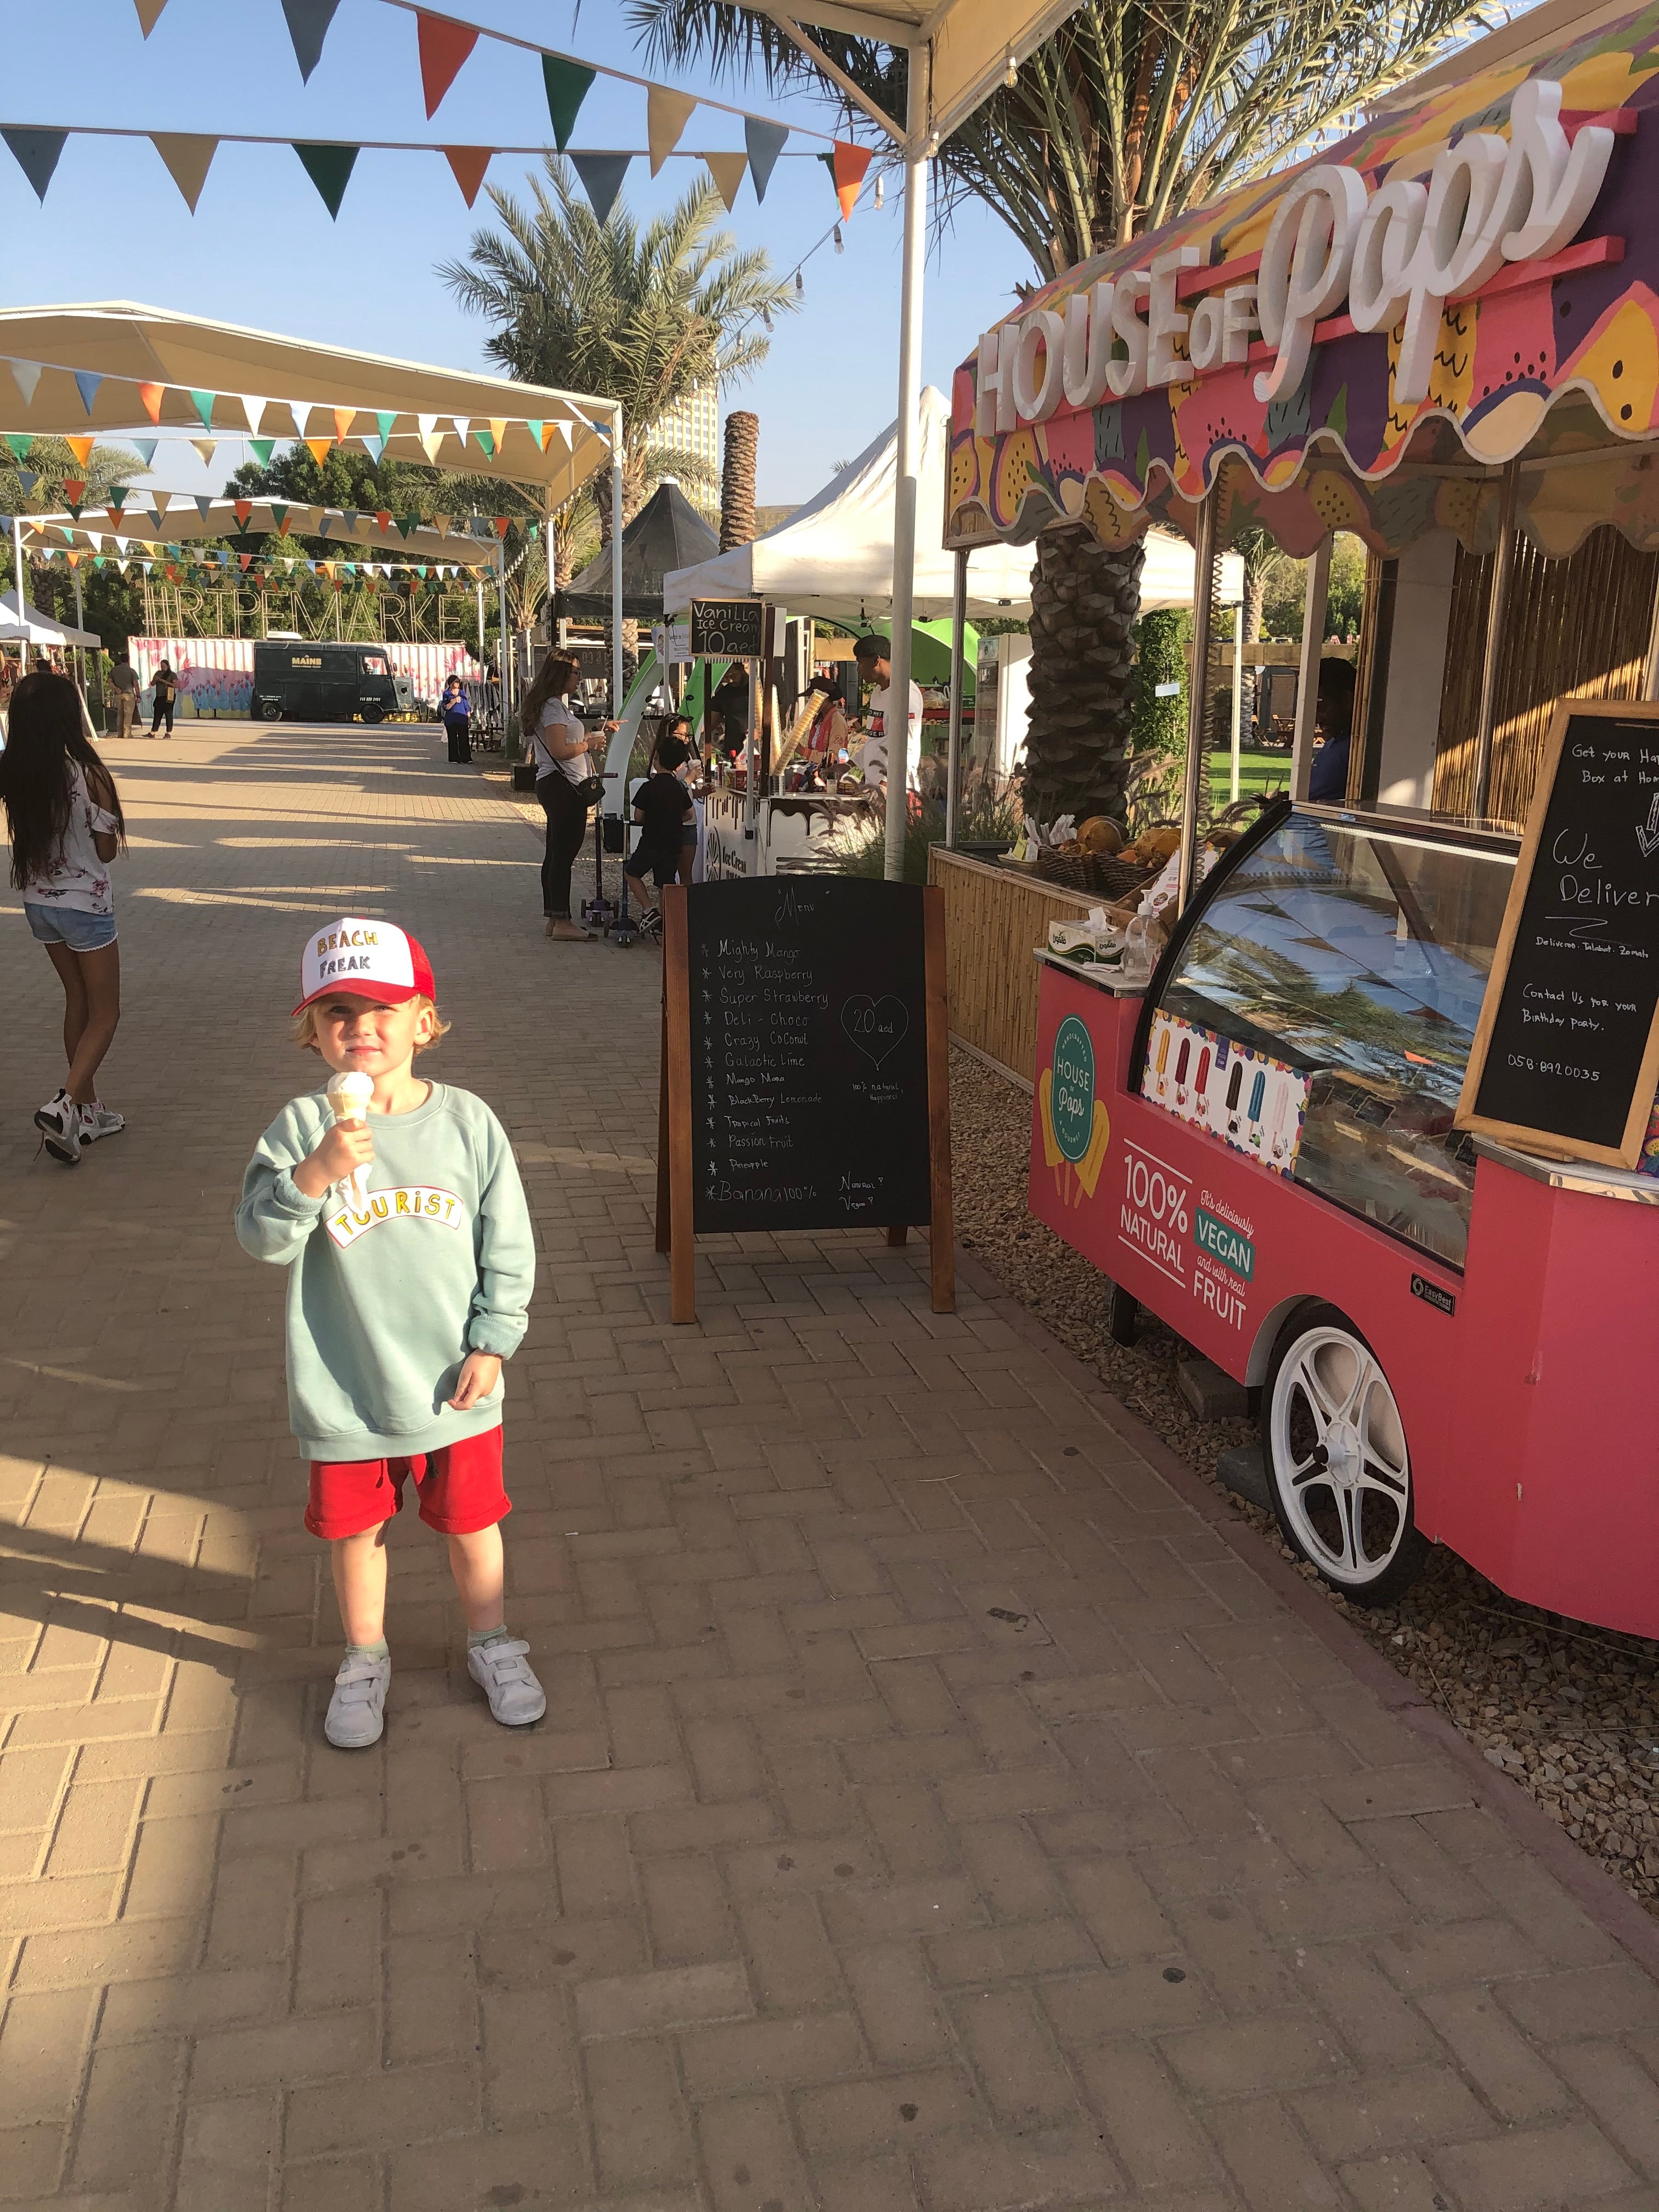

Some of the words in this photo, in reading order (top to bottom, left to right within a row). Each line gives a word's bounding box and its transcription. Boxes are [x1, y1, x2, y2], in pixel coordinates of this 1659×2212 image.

[975, 247, 1200, 438] HOUSE
[1188, 284, 1260, 369] OF
[1254, 80, 1615, 404] Pops
[693, 602, 759, 622] Vanilla
[696, 619, 715, 630] Ice
[720, 619, 760, 633] Cream
[698, 630, 725, 654] 10
[727, 635, 758, 653] aed
[1572, 743, 1595, 758] Get
[1582, 770, 1605, 784] Box
[1613, 770, 1628, 783] at
[723, 846, 731, 866] Ice
[1553, 828, 1602, 869] We
[1560, 874, 1659, 906] Deliver
[317, 930, 379, 957] BEACH
[717, 939, 758, 963] Mighty
[766, 941, 801, 965] Mango
[1618, 945, 1649, 959] Zomato
[320, 956, 371, 979] FREAK
[719, 965, 745, 985] Very
[754, 965, 813, 987] Raspberry
[720, 987, 758, 1007] Super
[764, 988, 828, 1009] Strawberry
[1522, 983, 1565, 1001] Contact
[1571, 991, 1584, 1005] Us
[725, 1011, 751, 1025] Deli
[771, 1012, 809, 1026] Choco
[854, 1009, 875, 1033] 20
[878, 1022, 894, 1033] aed
[1521, 1007, 1565, 1026] Birthday
[725, 1032, 760, 1052] Crazy
[1062, 1032, 1087, 1062] HANDCRAFTED
[725, 1052, 776, 1067] Galactic
[781, 1052, 805, 1066] Lime
[1508, 1053, 1601, 1081] 058-8920035
[726, 1072, 755, 1086] Mango
[1057, 1056, 1090, 1092] HOUSE
[852, 1081, 867, 1092] 100%
[781, 1092, 822, 1104] Lemonade
[870, 1094, 898, 1104] Happiness
[1058, 1087, 1085, 1122] Pops
[724, 1115, 761, 1128] Tropical
[766, 1114, 790, 1125] Fruits
[729, 1132, 766, 1148] Passion
[769, 1135, 794, 1148] Fruit
[1062, 1127, 1081, 1144] GOURMET
[728, 1159, 769, 1172] Pineapple
[1125, 1154, 1188, 1233] 100%
[1200, 1189, 1215, 1210] It's
[1216, 1199, 1254, 1240] deliciously
[1121, 1204, 1184, 1273] NATURAL
[1198, 1214, 1251, 1273] VEGAN
[1197, 1255, 1212, 1272] and
[1211, 1261, 1228, 1285] with
[1228, 1277, 1246, 1297] real
[1193, 1269, 1246, 1330] FRUIT
